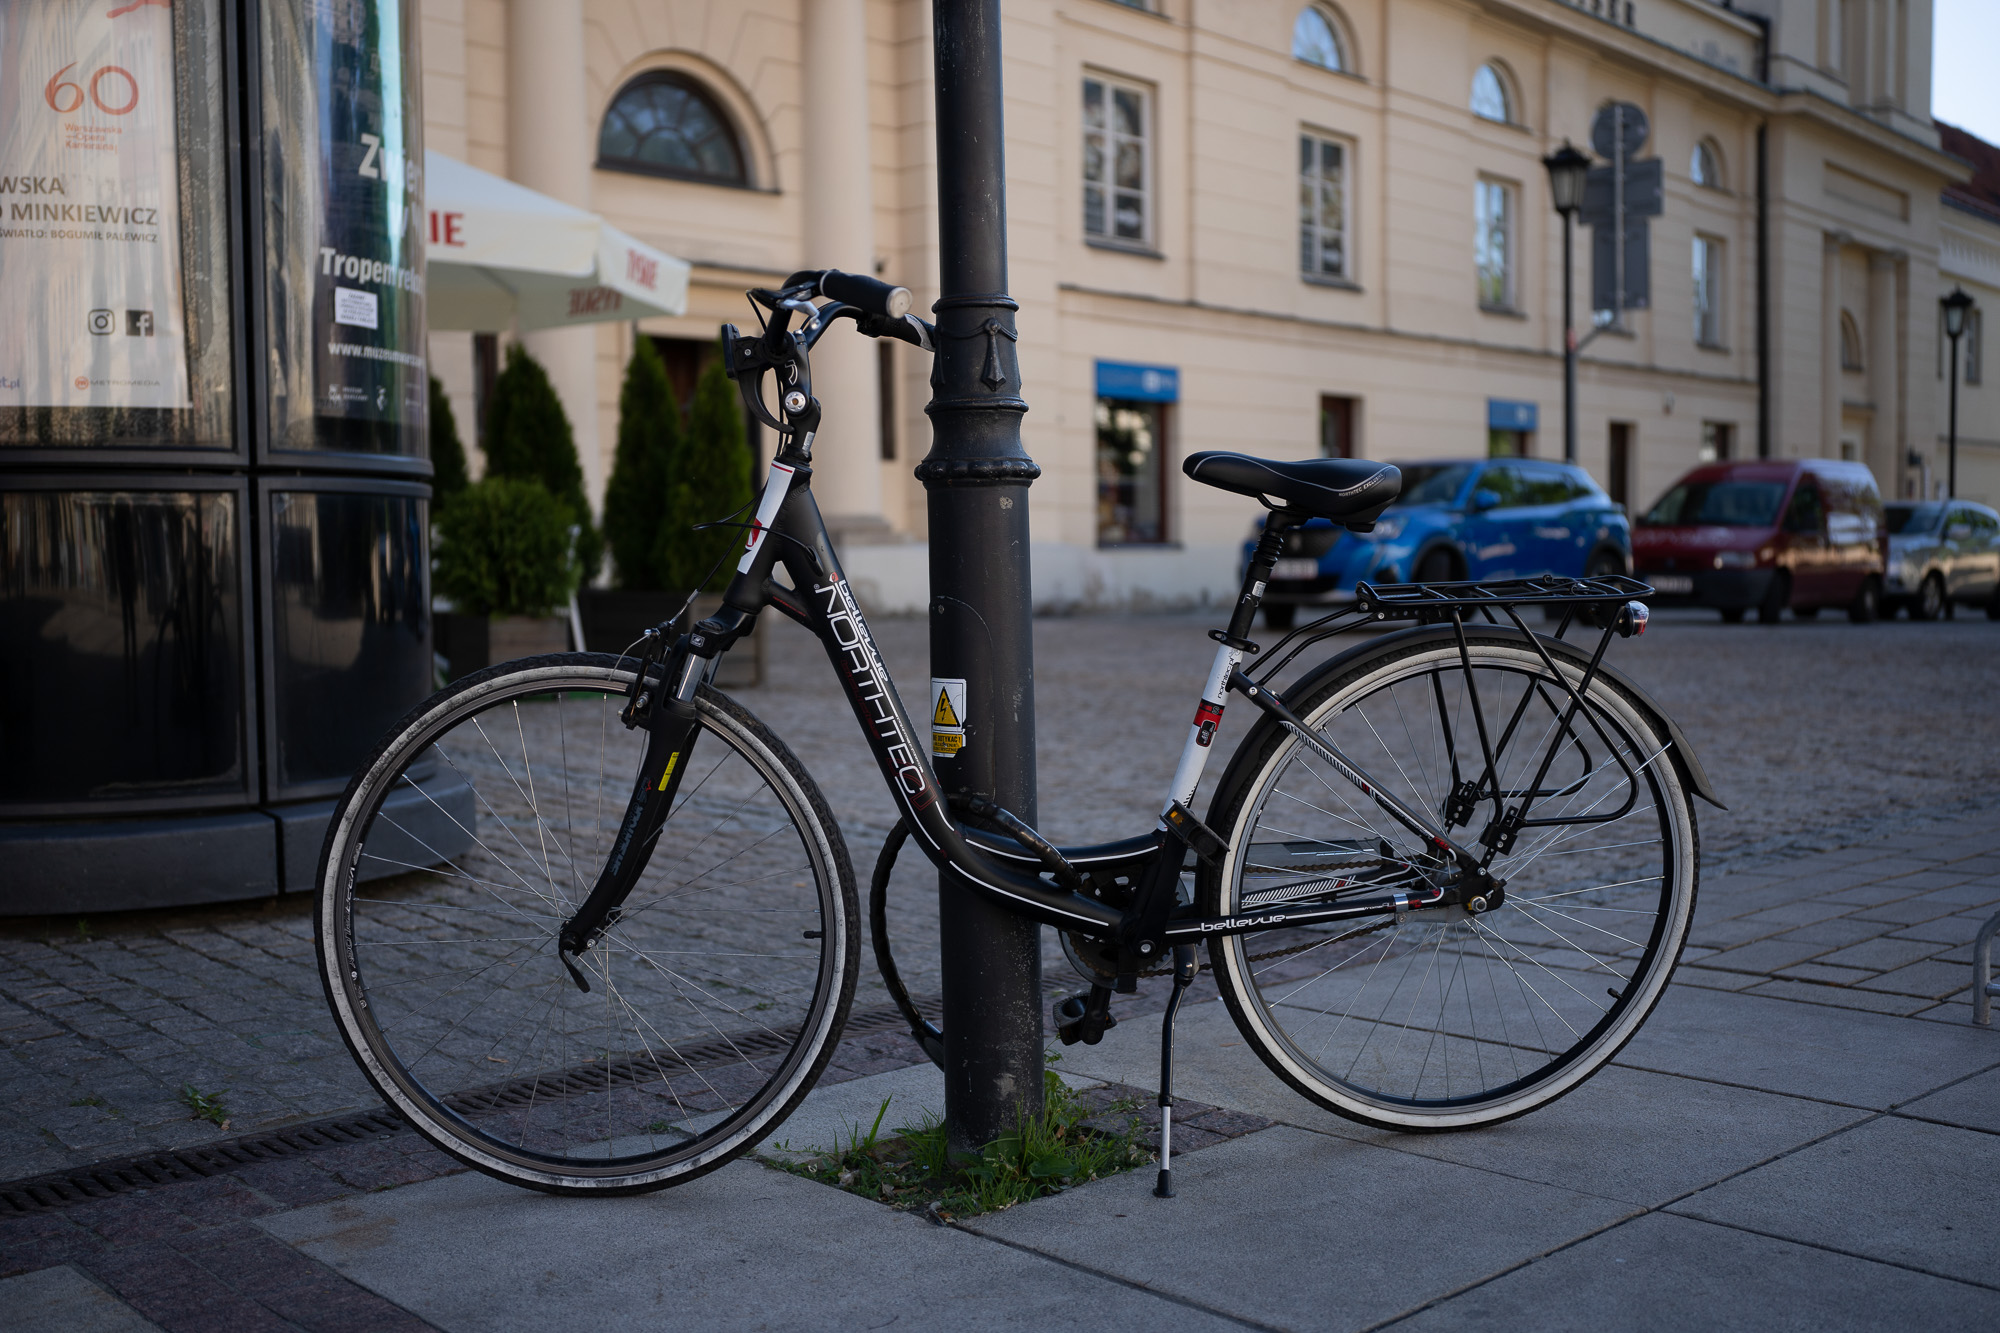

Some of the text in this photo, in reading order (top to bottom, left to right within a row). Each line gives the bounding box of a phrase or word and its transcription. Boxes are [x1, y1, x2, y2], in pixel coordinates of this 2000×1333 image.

[45, 61, 139, 116] 60
[11, 203, 158, 226] MINKIEWICZ
[427, 210, 466, 247] IE
[51, 229, 103, 241] BOGUMIŁ
[106, 232, 158, 243] PALEWICZ
[320, 246, 397, 286] Tropem
[839, 579, 889, 682] bellevue
[815, 585, 927, 795] NORTHTEC
[1200, 914, 1286, 932] bellevue
